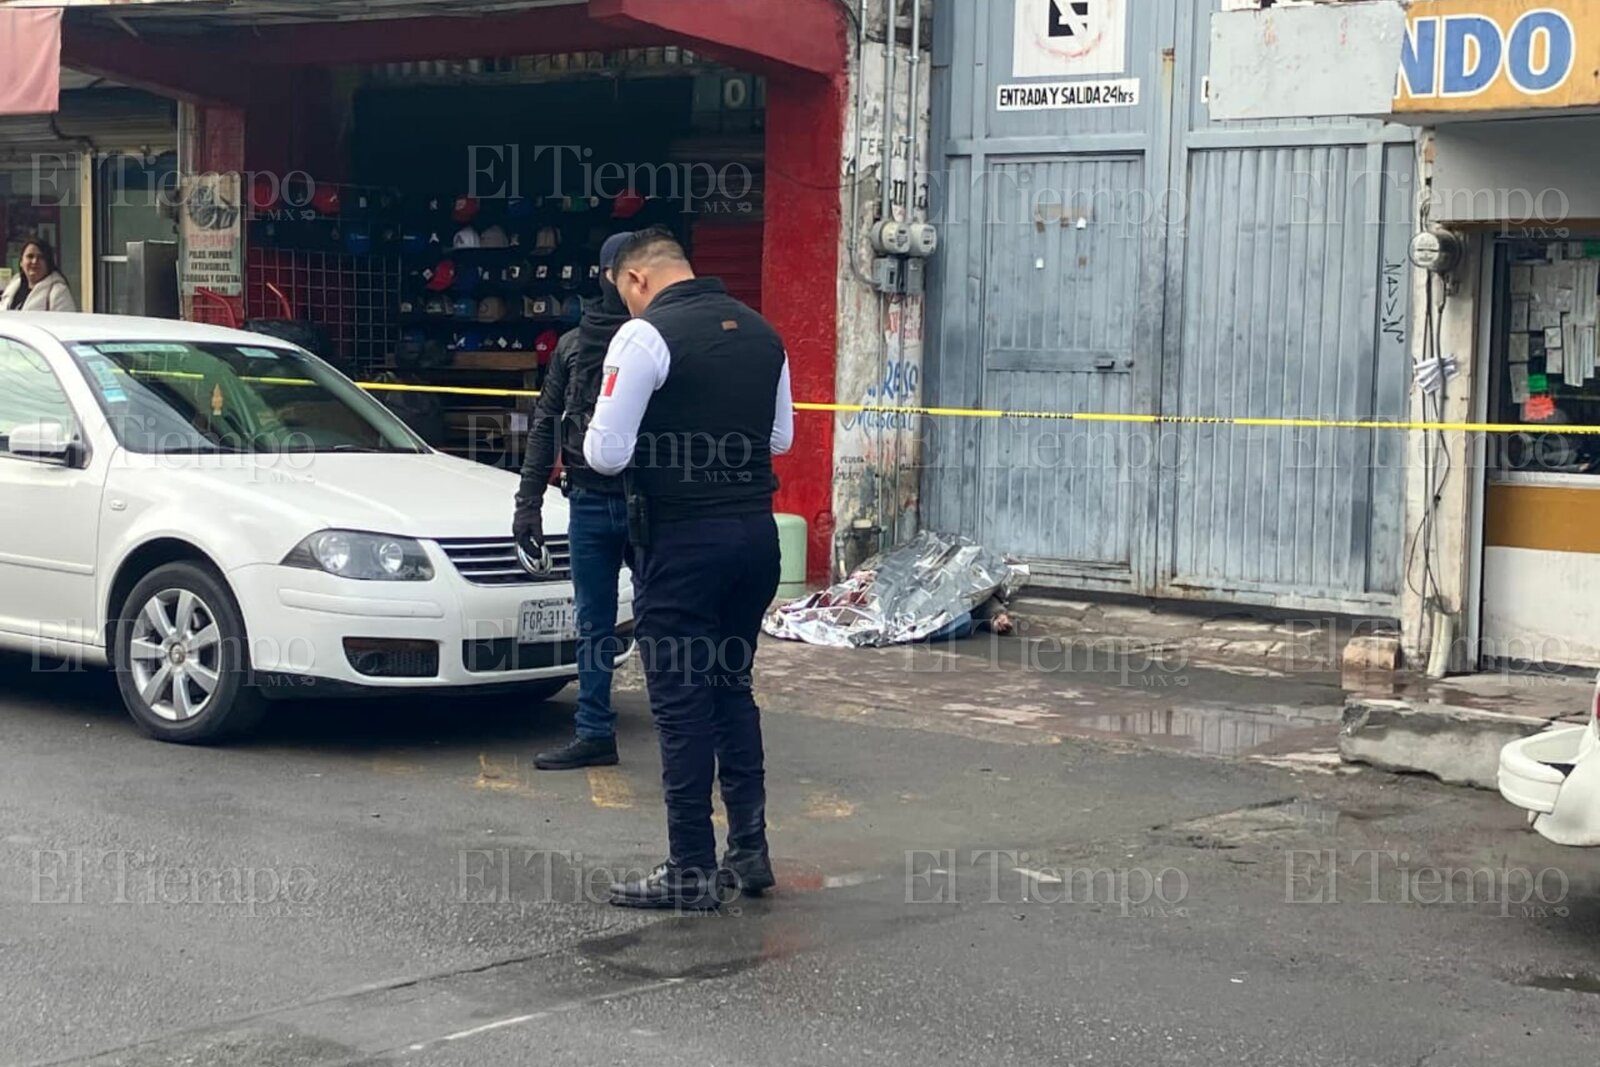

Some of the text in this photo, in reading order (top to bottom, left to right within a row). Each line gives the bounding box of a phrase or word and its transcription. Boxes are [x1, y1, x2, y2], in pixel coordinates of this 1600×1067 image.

[1000, 88, 1047, 106] ENTRADA
[1061, 85, 1100, 104] SALIDA
[1103, 85, 1135, 103] 24hrs
[523, 609, 577, 632] FGR-311-
